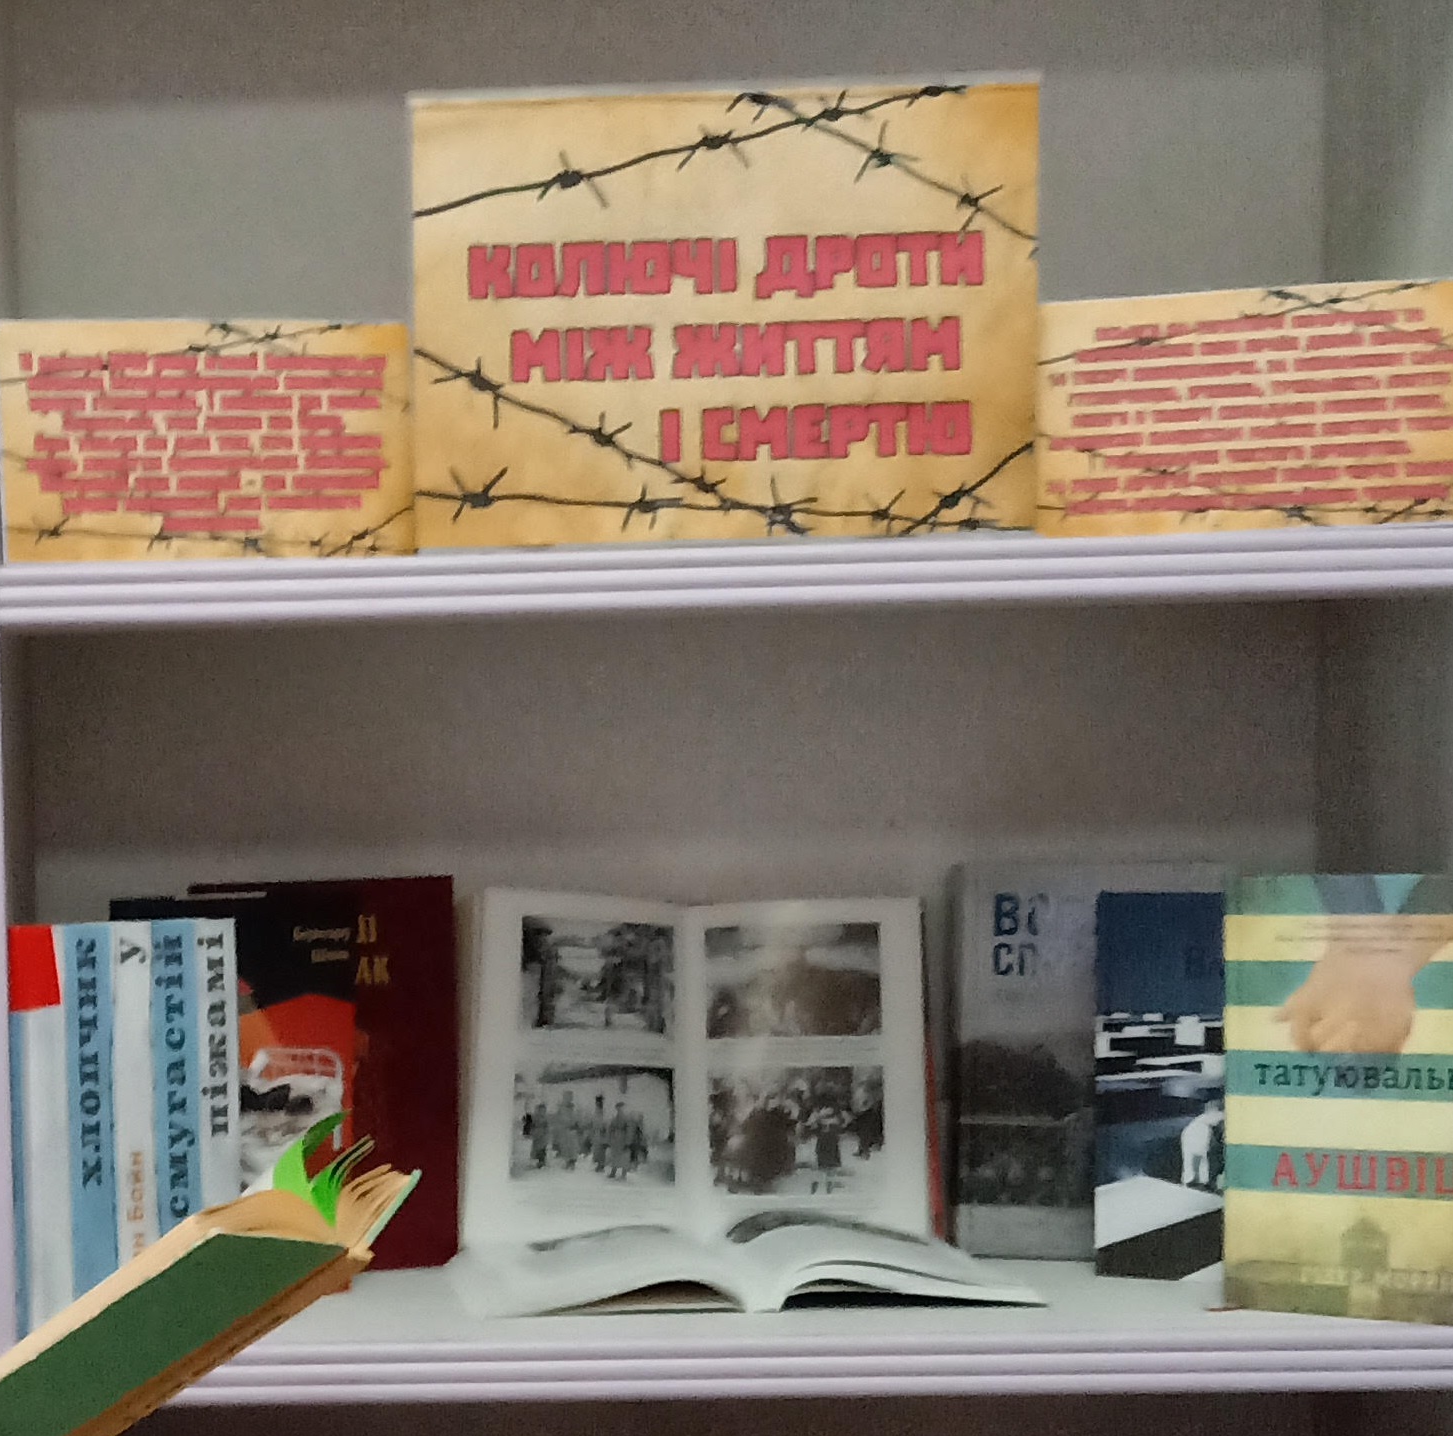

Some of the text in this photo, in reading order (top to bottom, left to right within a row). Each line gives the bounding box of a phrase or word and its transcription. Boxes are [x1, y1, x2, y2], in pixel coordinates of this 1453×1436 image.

[467, 230, 985, 300] КОЛЮЧІ ДРОТИ
[510, 315, 961, 383] МІЖ ЖИТТЯМ
[659, 399, 973, 463] І СМЕРТЮ
